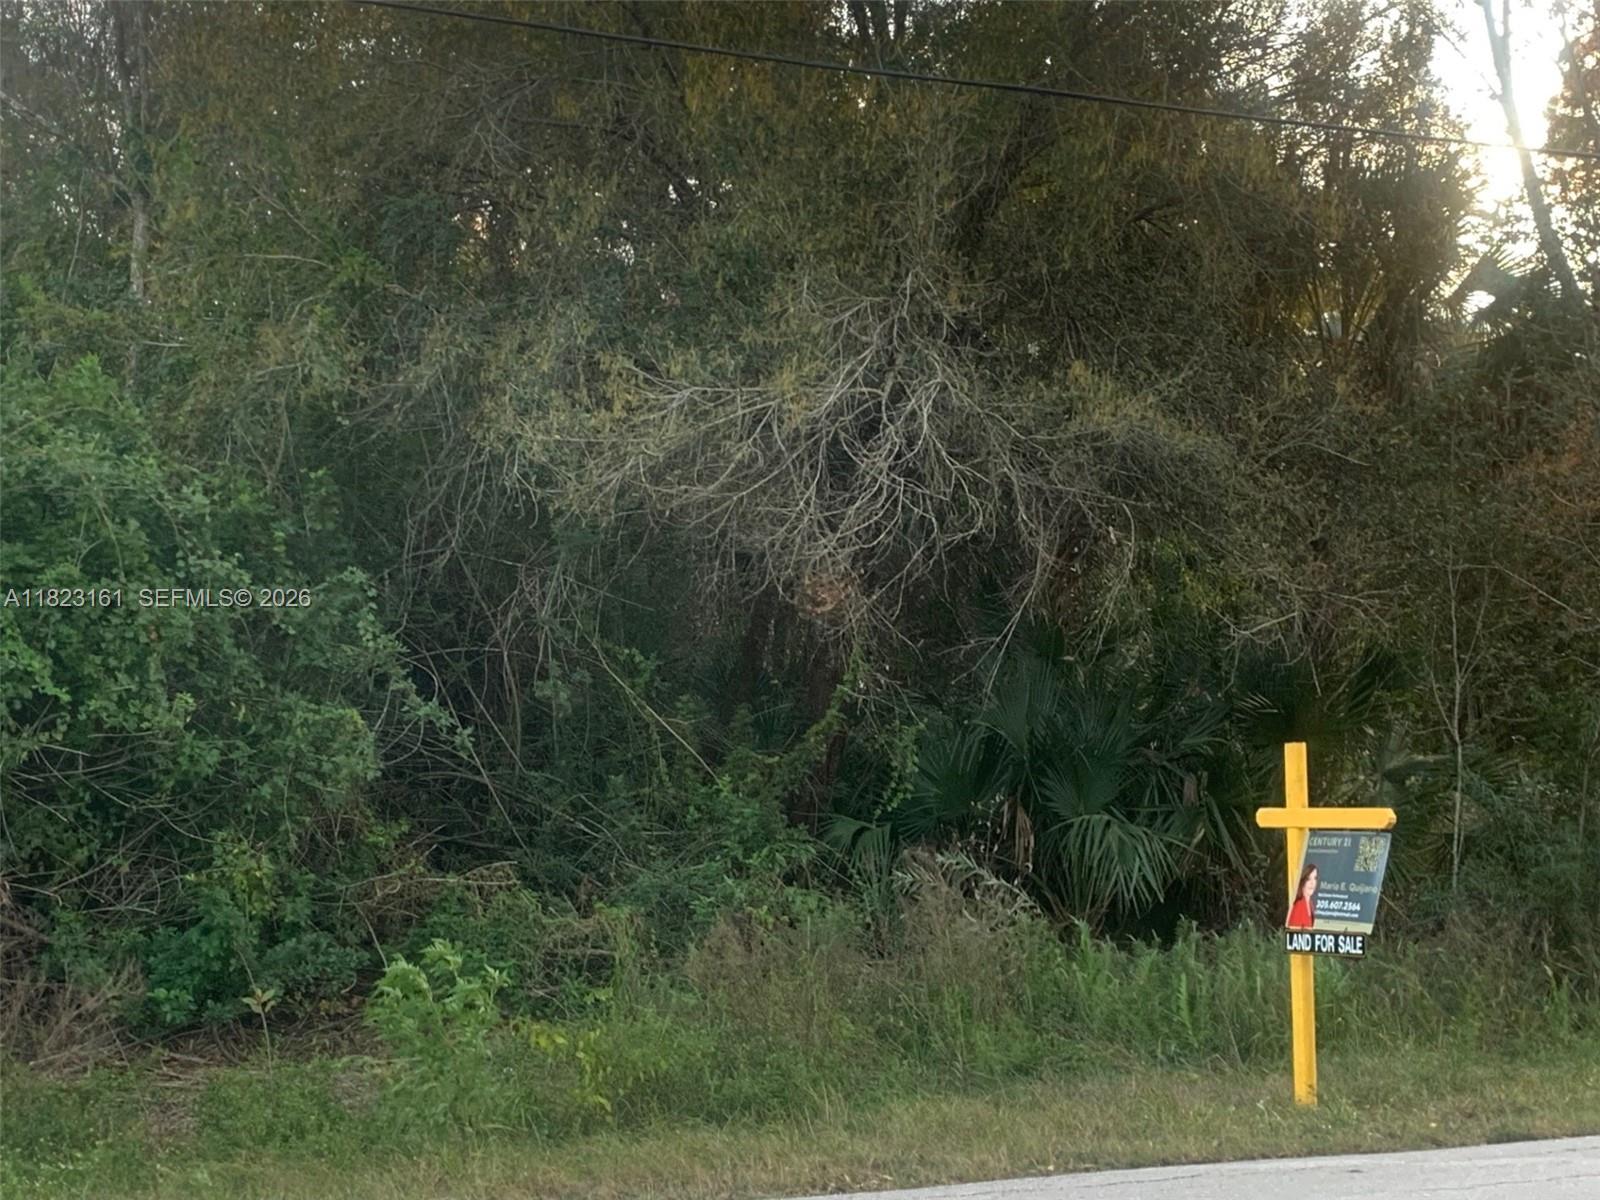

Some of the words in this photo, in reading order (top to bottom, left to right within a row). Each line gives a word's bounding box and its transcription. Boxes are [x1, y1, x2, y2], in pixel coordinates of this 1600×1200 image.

[1309, 837, 1342, 847] CENTURY
[1343, 838, 1352, 847] 21
[1316, 900, 1360, 911] 305.607.2564
[1286, 933, 1311, 951] LAND
[1315, 935, 1334, 952] FOR
[1338, 935, 1363, 953] SALE
